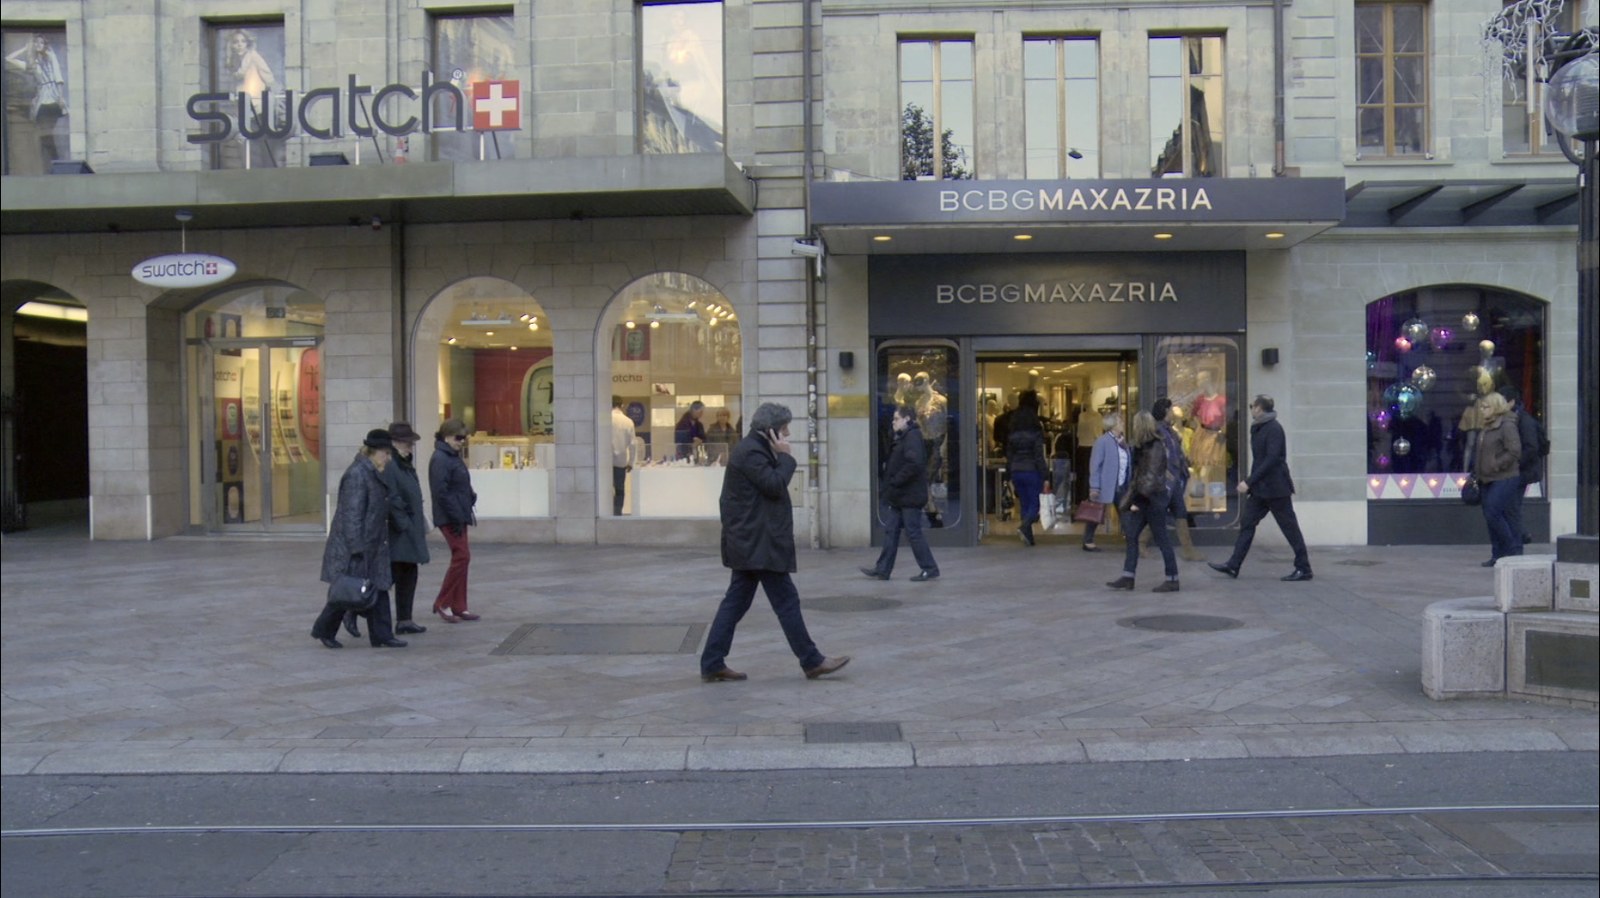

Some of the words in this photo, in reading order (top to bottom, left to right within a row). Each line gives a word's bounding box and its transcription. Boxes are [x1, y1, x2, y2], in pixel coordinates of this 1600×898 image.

[187, 70, 465, 143] swatch
[940, 188, 1213, 211] BCBGMAXAZRIA
[142, 260, 205, 278] swatch
[936, 282, 1178, 303] BCBGMAXAZRIA
